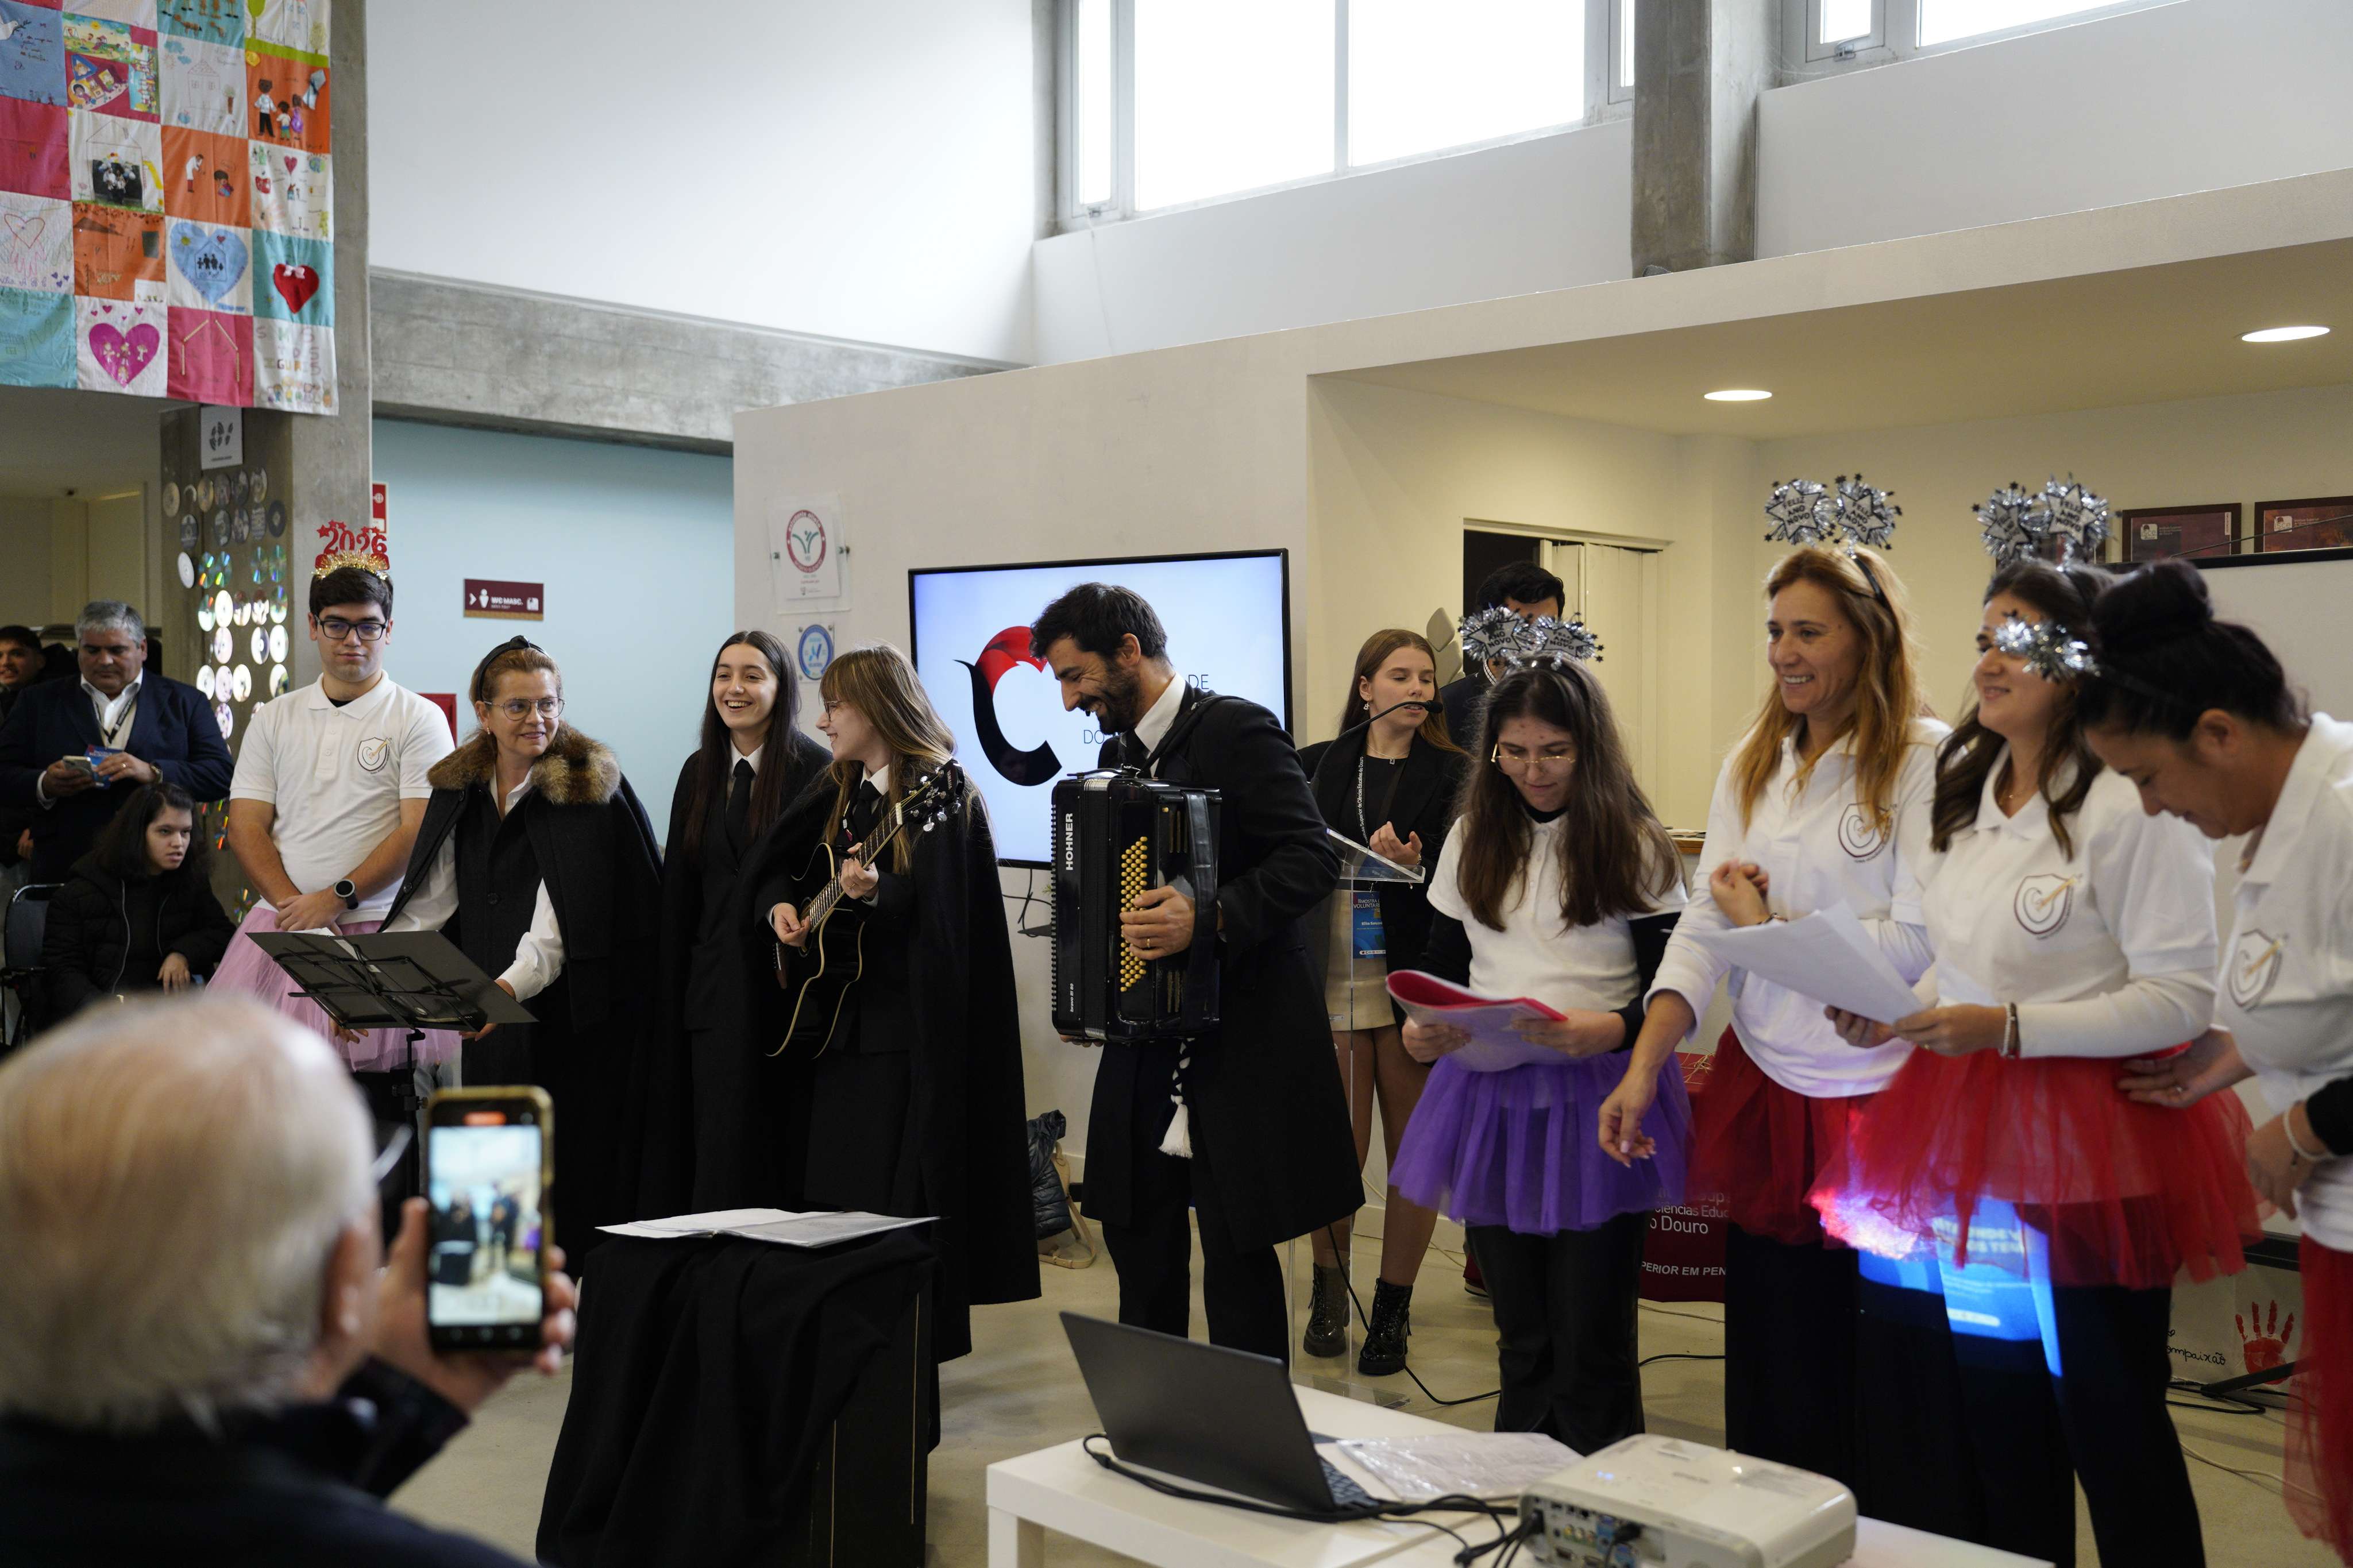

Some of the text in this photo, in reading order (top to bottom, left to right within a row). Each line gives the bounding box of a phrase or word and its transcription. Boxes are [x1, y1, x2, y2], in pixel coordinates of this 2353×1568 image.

[1783, 496, 1805, 509] FELIZ
[1788, 505, 1806, 516] ANO
[1851, 510, 1868, 524] ANO
[1787, 512, 1810, 525] NOVO
[1845, 513, 1867, 532] NOVO
[323, 528, 388, 554] 2026
[503, 597, 523, 605] MASC.
[1488, 637, 1512, 648] NOVO
[1550, 640, 1575, 650] NOVO
[1554, 636, 1573, 644] ANO
[1188, 674, 1209, 690] DE
[1083, 729, 1105, 744] DO
[1066, 813, 1074, 871] HOHNER
[1661, 1215, 1708, 1234] Douro
[1681, 1266, 1699, 1276] EM
